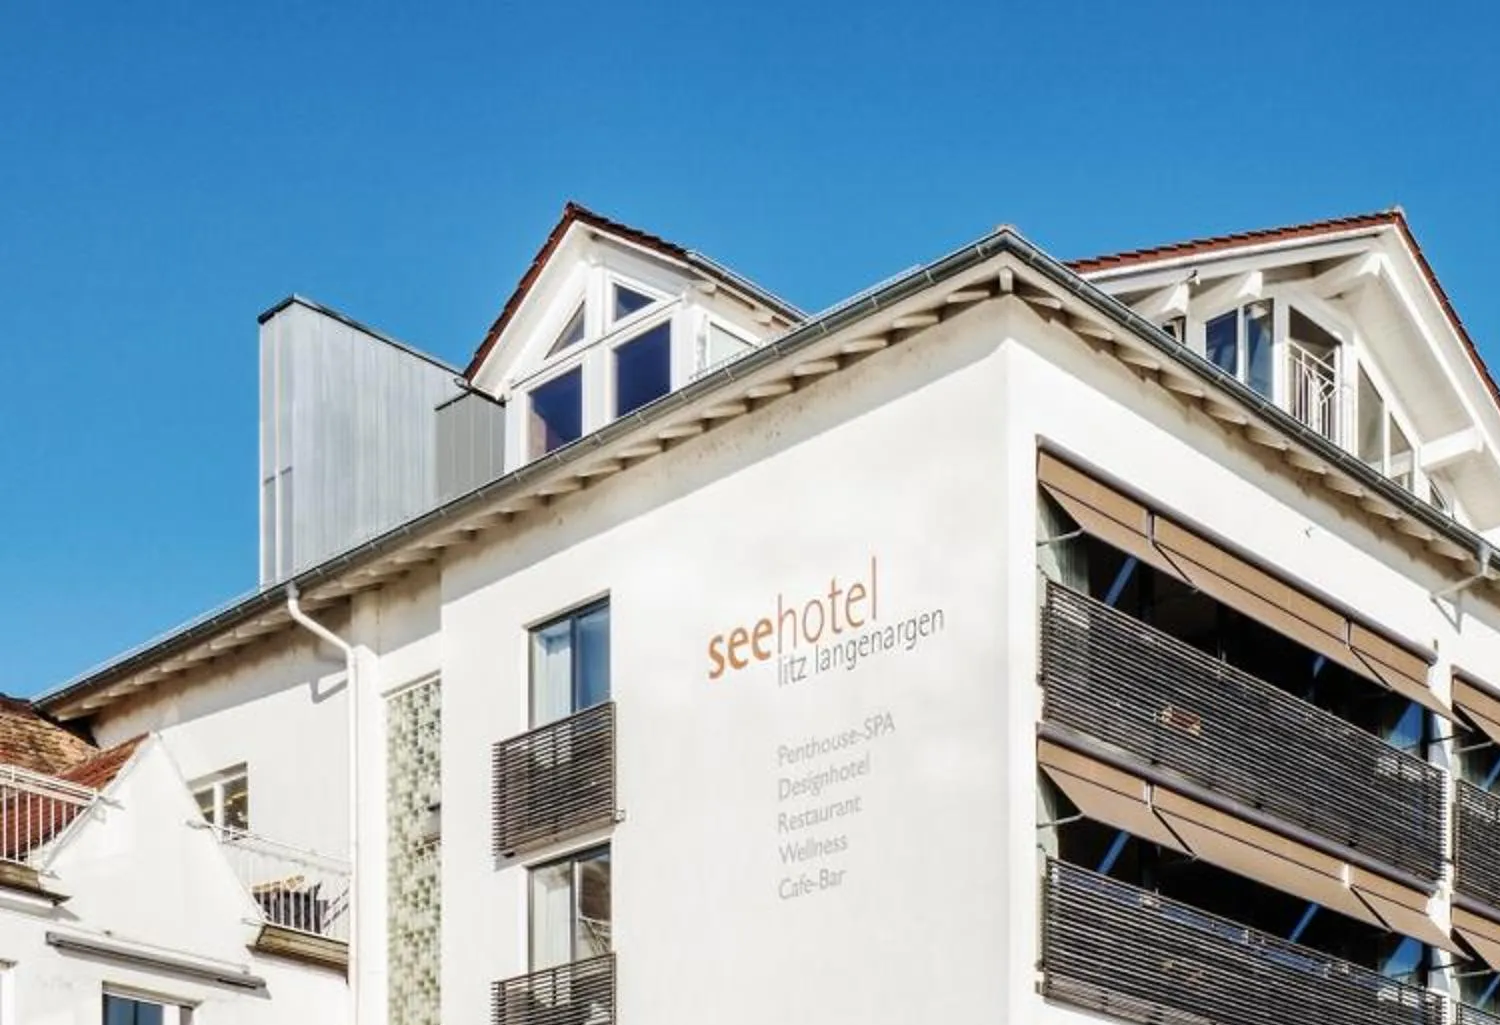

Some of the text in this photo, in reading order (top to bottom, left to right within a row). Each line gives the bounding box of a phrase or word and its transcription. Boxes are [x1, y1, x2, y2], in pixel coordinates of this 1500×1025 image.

[708, 556, 877, 680] seehotel
[778, 608, 945, 687] litz langenargen
[778, 712, 896, 767] Penthouse-SPA
[778, 751, 871, 800] Designhotel
[778, 796, 862, 834] Restaurant
[778, 835, 848, 864] Wellness
